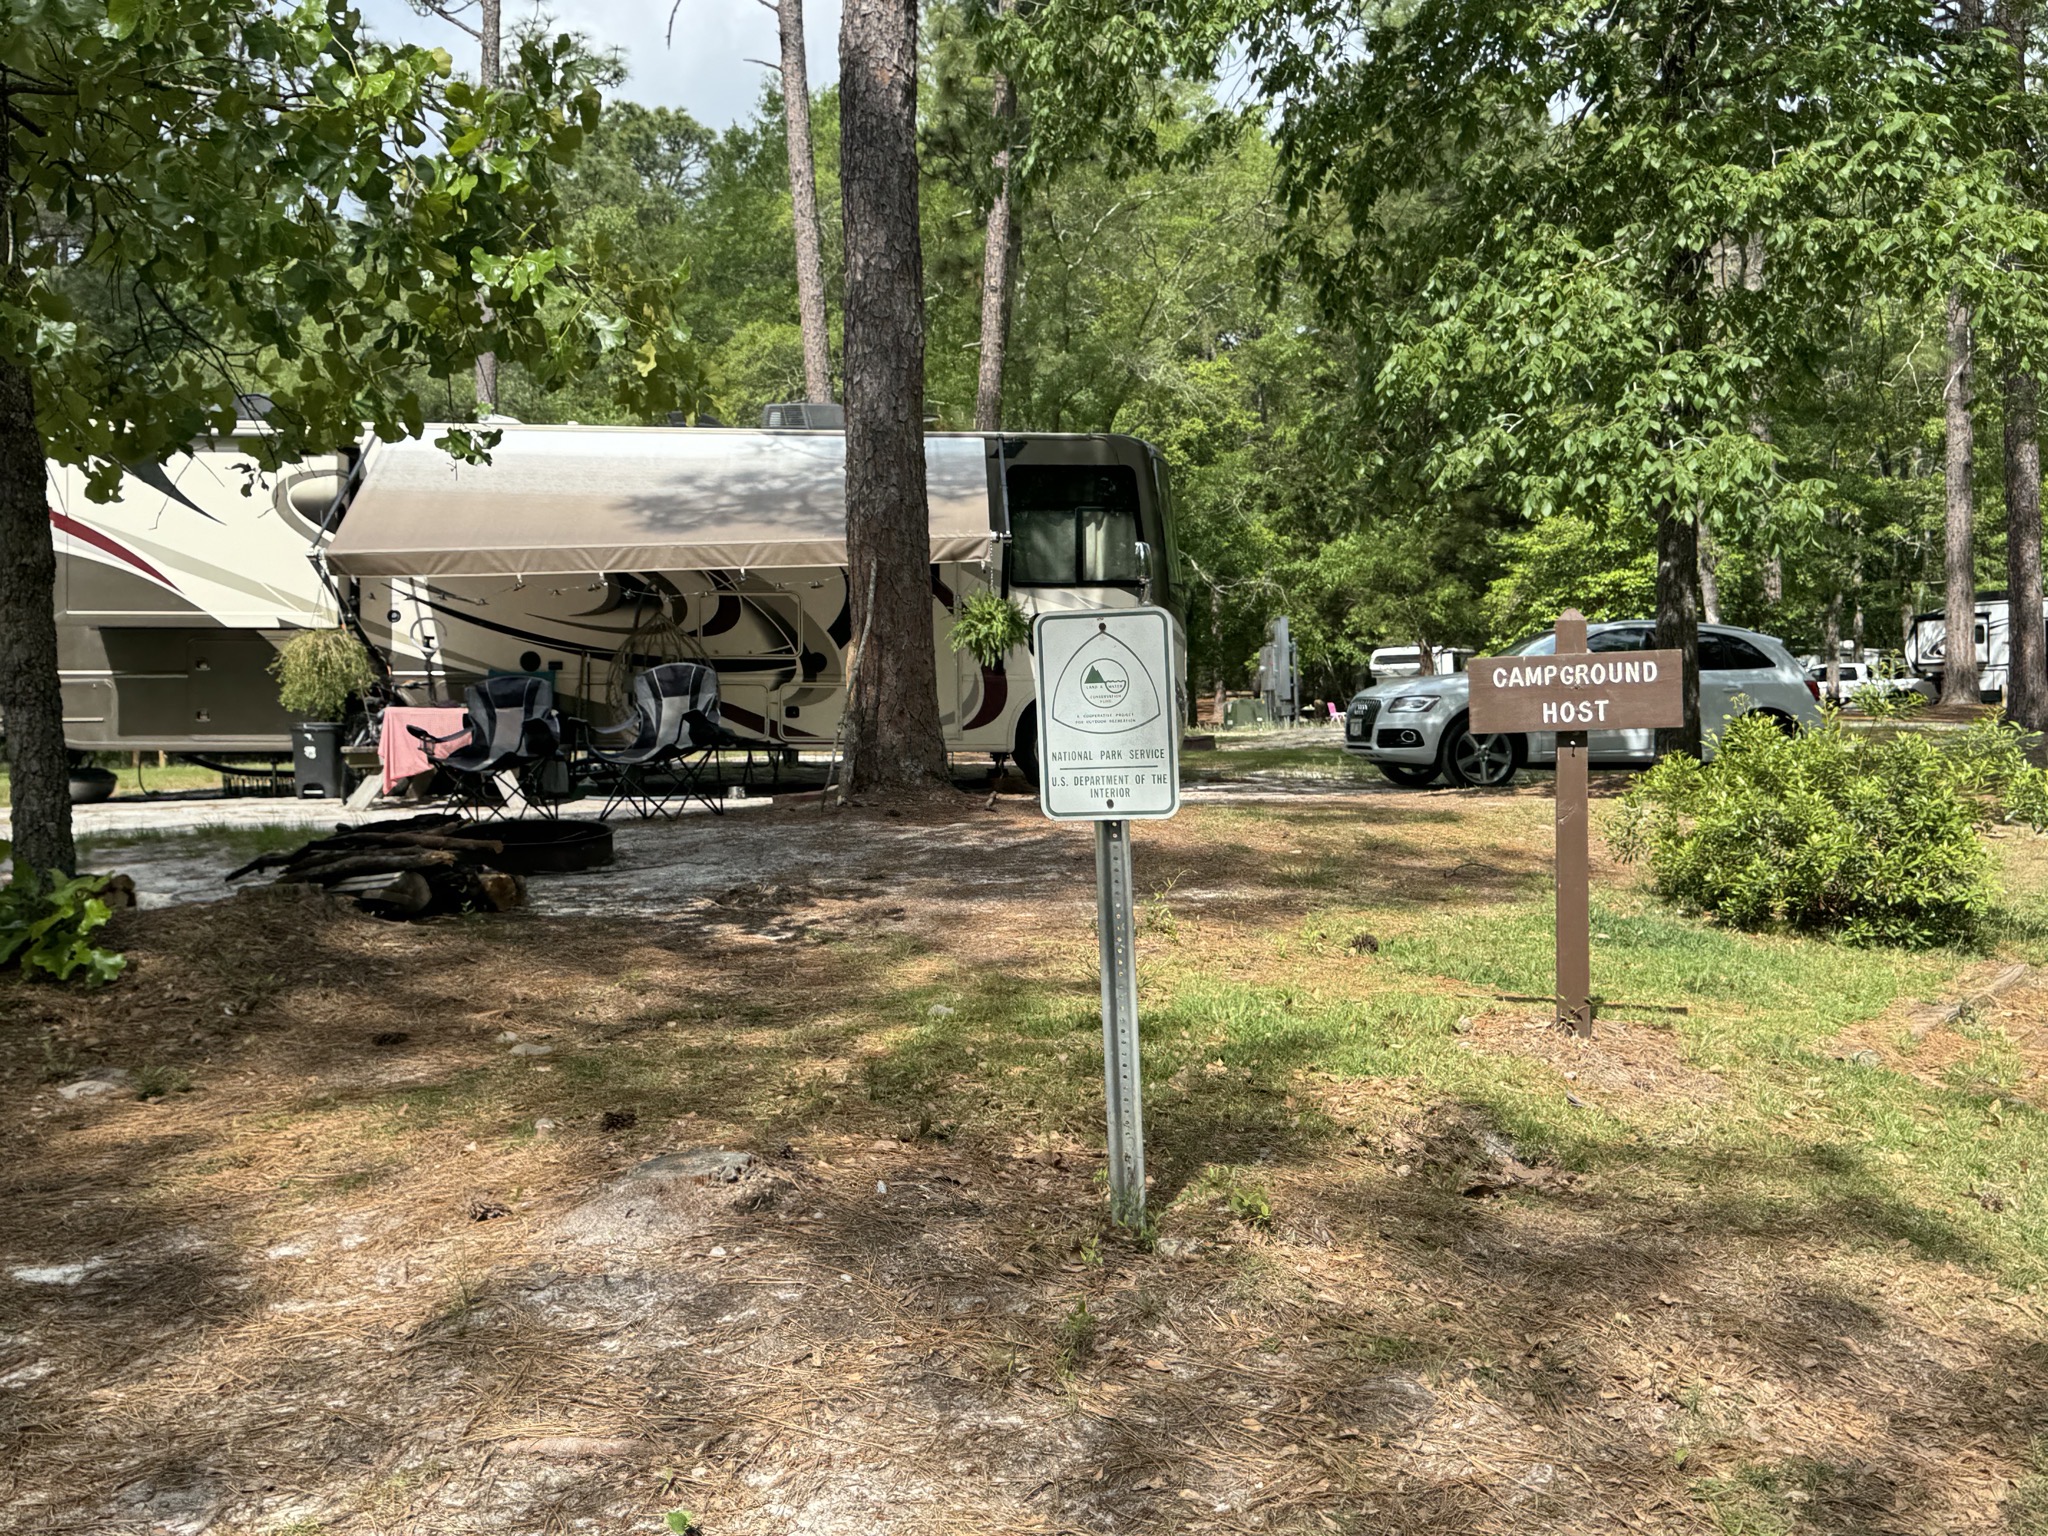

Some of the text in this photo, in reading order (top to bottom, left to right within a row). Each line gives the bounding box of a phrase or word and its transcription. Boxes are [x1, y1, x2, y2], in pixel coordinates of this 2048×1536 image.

[1492, 661, 1658, 688] CAMPGROUND
[1542, 699, 1610, 724] HOST
[1051, 748, 1165, 761] NATIONAL PARK SERVICE
[1051, 773, 1168, 787] U.S. DEPARTMENT OF THE
[1090, 788, 1131, 798] INTERIOR
